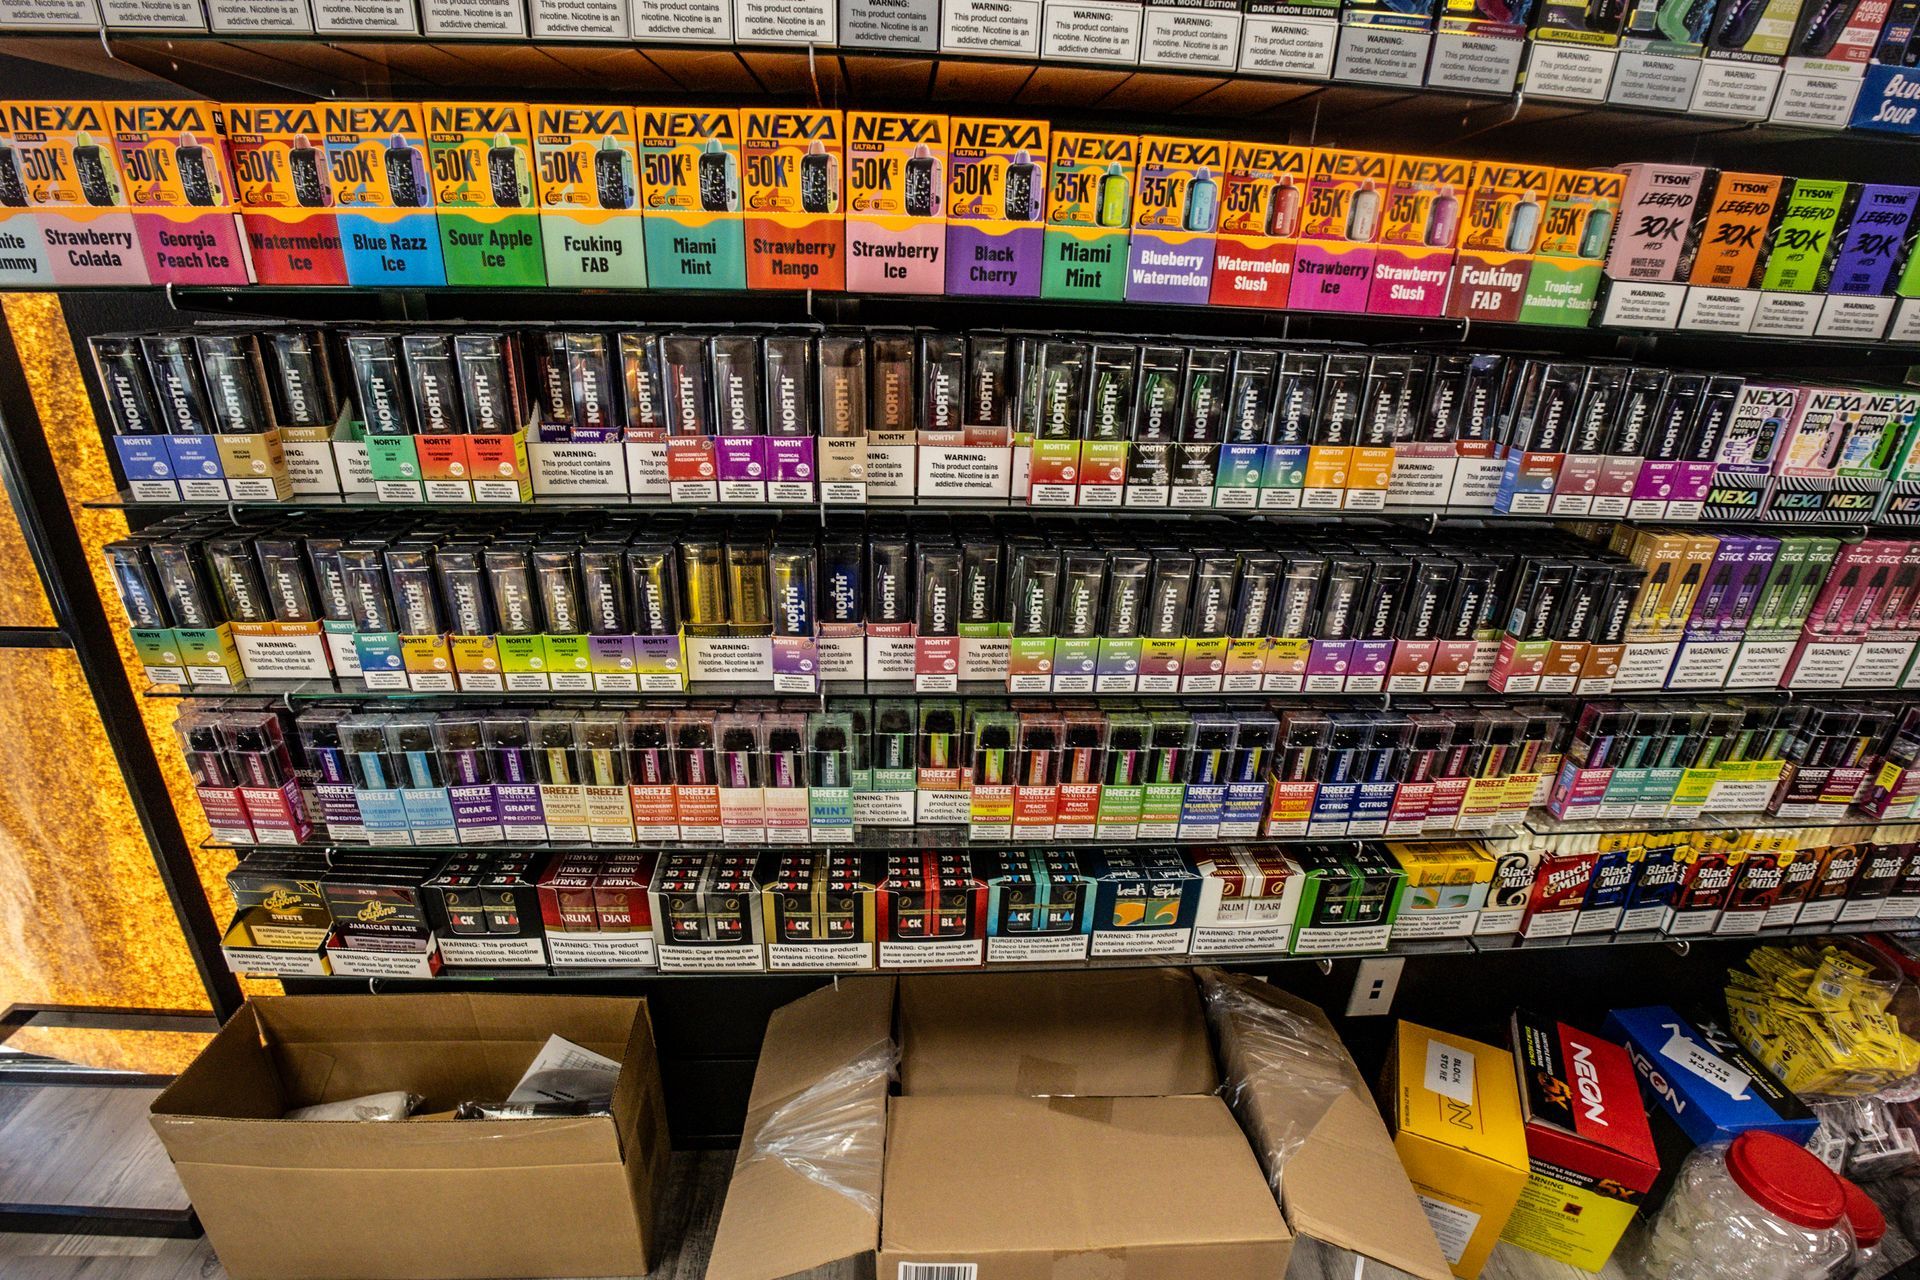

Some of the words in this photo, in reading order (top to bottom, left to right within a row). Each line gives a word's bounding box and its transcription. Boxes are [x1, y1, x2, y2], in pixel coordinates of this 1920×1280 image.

[1073, 11, 1113, 21] WARNING:
[1251, 5, 1275, 13] DARK
[1276, 6, 1301, 15] MOON
[1302, 8, 1334, 17] EDITION
[1855, 12, 1883, 23] PUFFS
[1056, 22, 1070, 30] This
[1072, 23, 1099, 33] product
[1100, 25, 1128, 33] contains
[1551, 30, 1578, 40] SKYFALL
[1579, 33, 1605, 42] EDITION
[1053, 33, 1082, 42] nicotine.
[1083, 34, 1112, 44] Nicotine
[1113, 36, 1120, 44] is
[1058, 44, 1088, 54] addictive
[1090, 46, 1122, 56] chemical.
[1824, 63, 1850, 72] EDITION
[10, 105, 102, 131] NEXA
[114, 105, 205, 131] NEXA
[231, 108, 319, 133] NEXA
[326, 108, 416, 132] NEXA
[431, 107, 521, 132] NEXA
[1872, 99, 1918, 125] SOUR
[538, 110, 629, 135] NEXA
[644, 112, 733, 138] NEXA
[747, 114, 836, 140] NEXA
[852, 116, 942, 142] NEXA
[955, 123, 1042, 149] NEXA
[1058, 136, 1132, 161] NEXA
[1146, 141, 1221, 167] NEXA
[23, 148, 67, 182] 50K
[126, 148, 168, 182] 50K
[645, 154, 687, 186] 50K
[1232, 148, 1304, 173] NEXA
[1316, 153, 1386, 177] NEXA
[953, 164, 992, 195] 50K
[1396, 160, 1465, 185] NEXA
[1480, 167, 1547, 191] NEXA
[1654, 174, 1690, 185] TYSON
[1055, 172, 1090, 203] 35K
[1556, 174, 1621, 198] NEXA
[1733, 182, 1768, 193] TYSON
[1798, 187, 1833, 198] TYSON
[1227, 182, 1264, 213] 35K
[1638, 192, 1693, 207] LEGEND
[1873, 194, 1906, 204] TYSON
[1717, 200, 1770, 215] LEGEND
[1786, 206, 1835, 220] LEGEND
[1546, 207, 1583, 237] 35K
[1630, 215, 1686, 241] 30K
[45, 228, 132, 250] Strawberry
[158, 230, 216, 250] Georgia
[251, 231, 342, 250] Watermelon
[353, 233, 387, 250] Blue
[391, 234, 427, 251] Razz
[448, 229, 484, 246] Sour
[488, 230, 533, 249] Apple
[1708, 222, 1762, 249] 30K
[1775, 228, 1827, 252] 30K
[564, 236, 622, 256] Fcuking
[673, 238, 716, 255] Miami
[753, 238, 836, 257] Strawberry
[852, 240, 938, 262] Strawberry
[974, 245, 1014, 262] Black
[1060, 242, 1111, 264] Miami
[68, 250, 122, 267] Colada
[158, 252, 201, 268] Peach
[206, 254, 229, 268] Ice
[288, 254, 312, 271] Ice
[382, 255, 406, 271] Ice
[482, 251, 505, 267] Ice
[581, 257, 609, 272] FAB
[680, 258, 711, 275] Mint
[1141, 250, 1203, 270] Blueberry
[1217, 255, 1290, 275] Watermelon
[771, 259, 819, 279] Mango
[883, 263, 907, 279] Ice
[969, 266, 1017, 286] Cherry
[1065, 268, 1102, 288] Mint
[1132, 270, 1208, 287] Watermelon
[1298, 259, 1369, 279] Strawberry
[1376, 264, 1446, 286] Strawberry
[1234, 276, 1267, 291] Slush
[1320, 279, 1340, 295] Ice
[1461, 266, 1523, 292] Fcuking
[1544, 280, 1584, 295] Tropical
[1391, 285, 1425, 301] Slush
[1470, 291, 1502, 310] FAB
[1525, 294, 1565, 308] Rainbow
[115, 376, 143, 430] NORTH
[285, 369, 309, 422] NORTH
[424, 374, 444, 429] NORTH
[584, 370, 600, 423] NORTH
[730, 376, 745, 430] NORTH
[1743, 390, 1795, 407] NEXA
[1811, 396, 1861, 411] NEXA
[1147, 386, 1165, 439] NORTH
[1738, 406, 1760, 416] PRO
[1708, 490, 1759, 505] NEXA
[647, 584, 662, 630] NORTH
[934, 586, 946, 632] NORTH
[1568, 596, 1591, 638] NORTH
[452, 787, 490, 797] BREEZE
[498, 786, 536, 796] BREEZE
[634, 787, 672, 796] BREEZE
[974, 786, 1012, 796] BREEZE
[1188, 787, 1225, 797] BREEZE
[1320, 785, 1356, 795] BREEZE
[505, 804, 536, 812] GRAPE
[814, 806, 848, 816] MINT
[1358, 801, 1388, 809] CITRUS
[1500, 866, 1536, 878] Black
[1549, 860, 1591, 885] Black
[1601, 863, 1634, 877] Black
[1698, 867, 1734, 879] Black
[1501, 876, 1533, 889] Mild
[1557, 871, 1590, 894] Mild
[1602, 873, 1632, 887] Mild
[1699, 876, 1729, 889] Mild
[262, 896, 302, 910] Capone
[357, 906, 397, 922] Capone
[349, 923, 390, 932] JAMAICAN
[1834, 958, 1854, 971] TOP
[1784, 1042, 1798, 1055] TOP
[1452, 1058, 1462, 1085] BLOCK
[1688, 1058, 1728, 1083] BLOCK
[1570, 1041, 1609, 1127] NEON
[1529, 1158, 1564, 1174] UINTUPLE
[1565, 1170, 1594, 1183] REFINED
[1555, 1174, 1583, 1187] BUTANE
